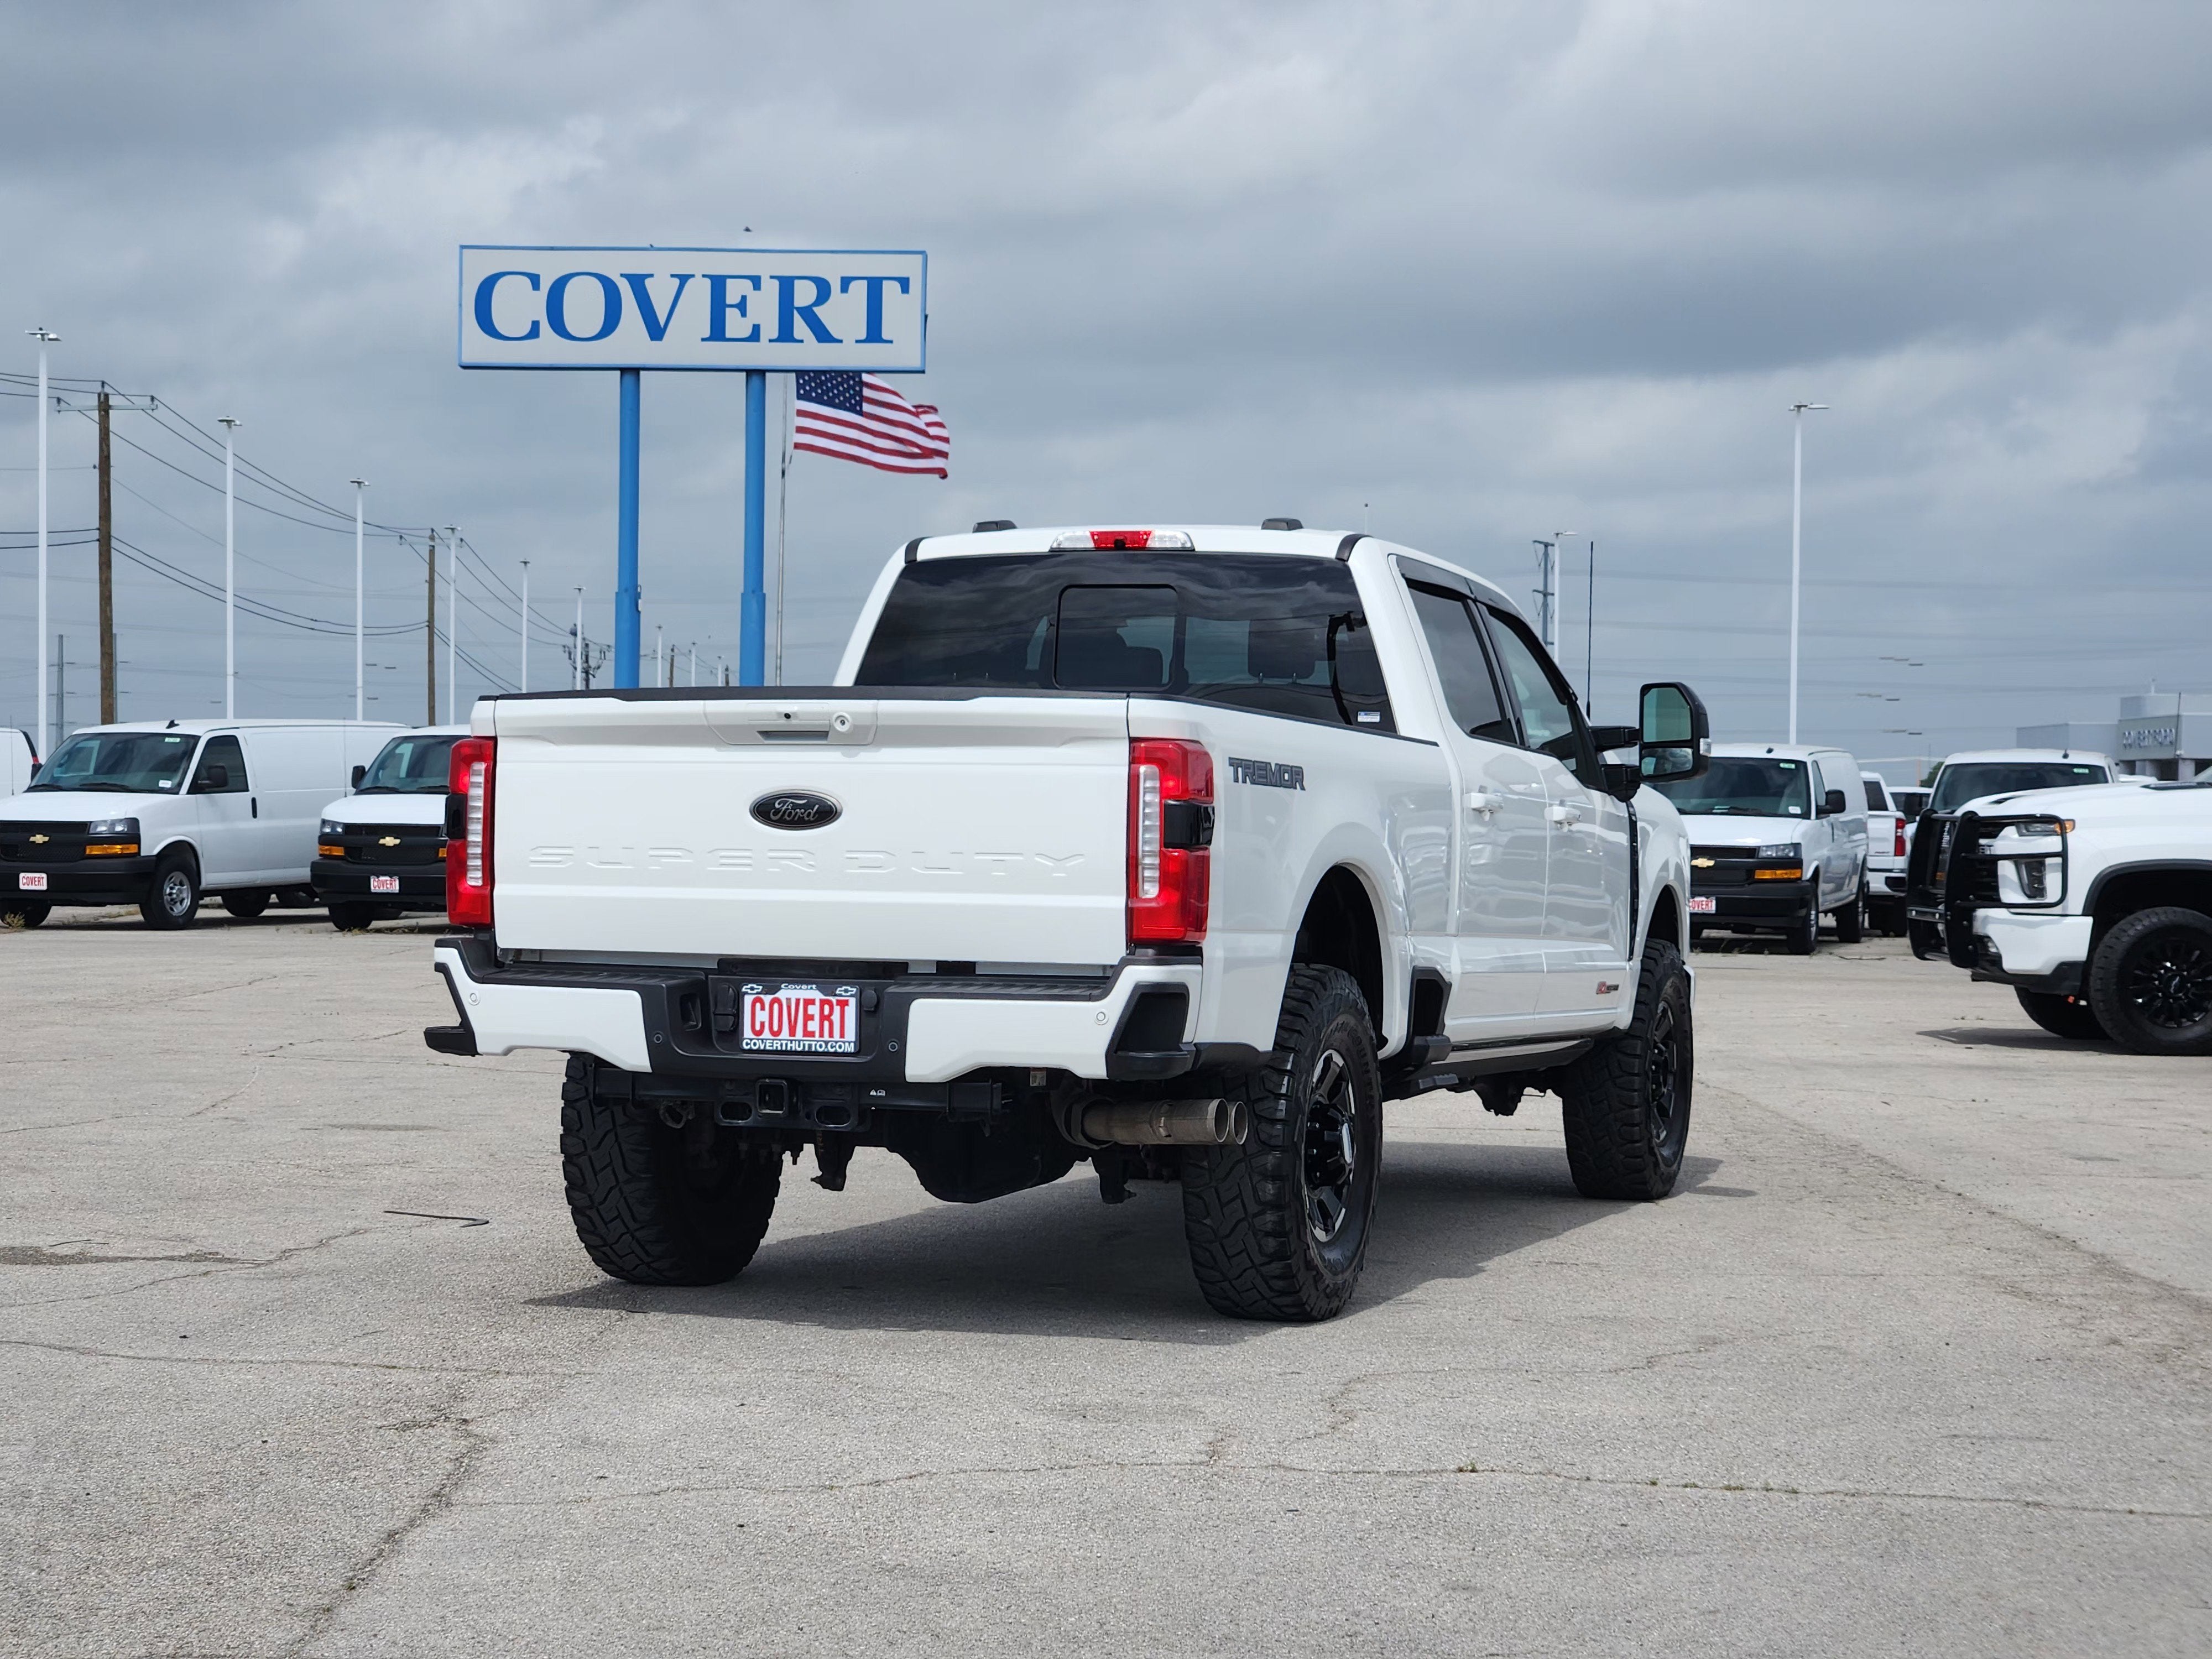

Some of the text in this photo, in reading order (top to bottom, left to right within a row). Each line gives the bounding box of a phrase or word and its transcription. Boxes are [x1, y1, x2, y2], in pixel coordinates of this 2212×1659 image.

[474, 271, 910, 344] COVERT
[1228, 757, 1306, 791] TREMOR
[770, 798, 820, 821] Ford
[529, 846, 1085, 877] SUPER DUTY
[22, 876, 44, 886] COVERT
[373, 878, 396, 889] COVERT
[750, 995, 849, 1039] COVERT
[743, 1039, 854, 1053] COVERTHUTTO.COM
